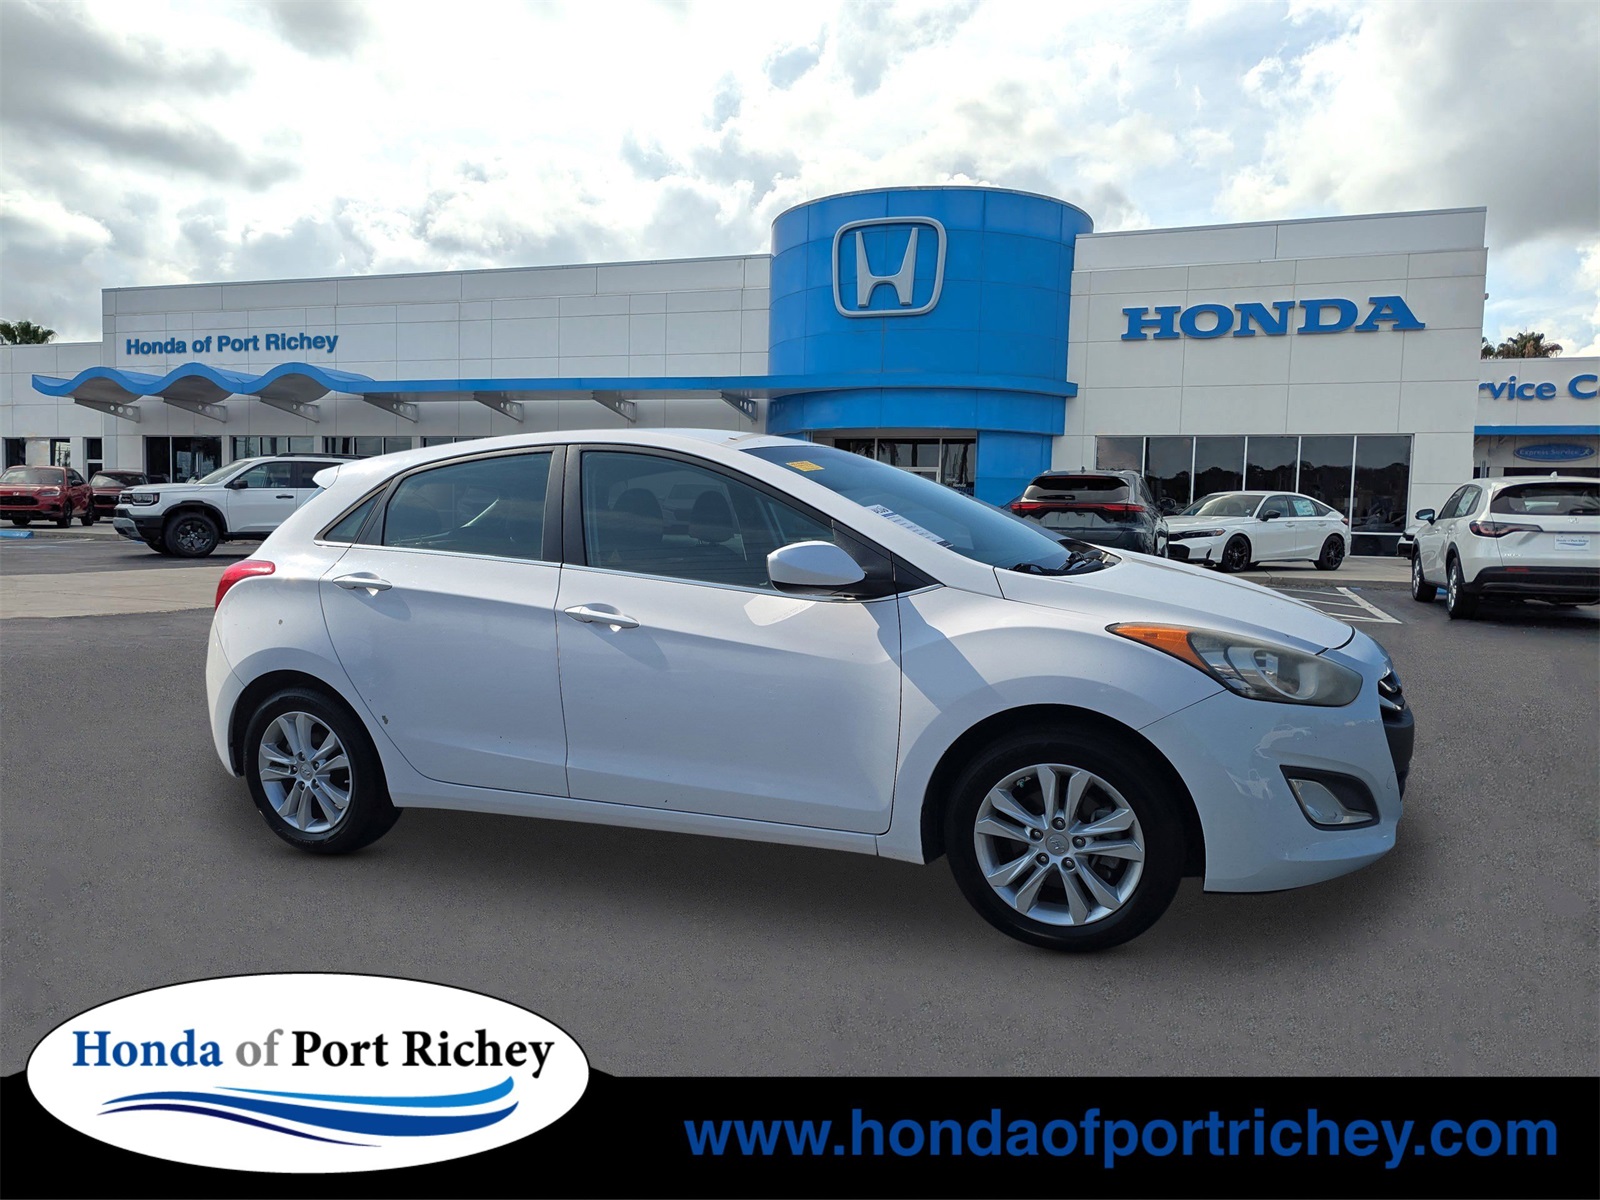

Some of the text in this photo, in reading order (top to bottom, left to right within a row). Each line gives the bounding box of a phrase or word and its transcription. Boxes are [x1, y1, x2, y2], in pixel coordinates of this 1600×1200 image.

[1121, 296, 1426, 340] HONDA
[126, 332, 339, 355] Honda of Port Richey
[1567, 373, 1600, 400] C
